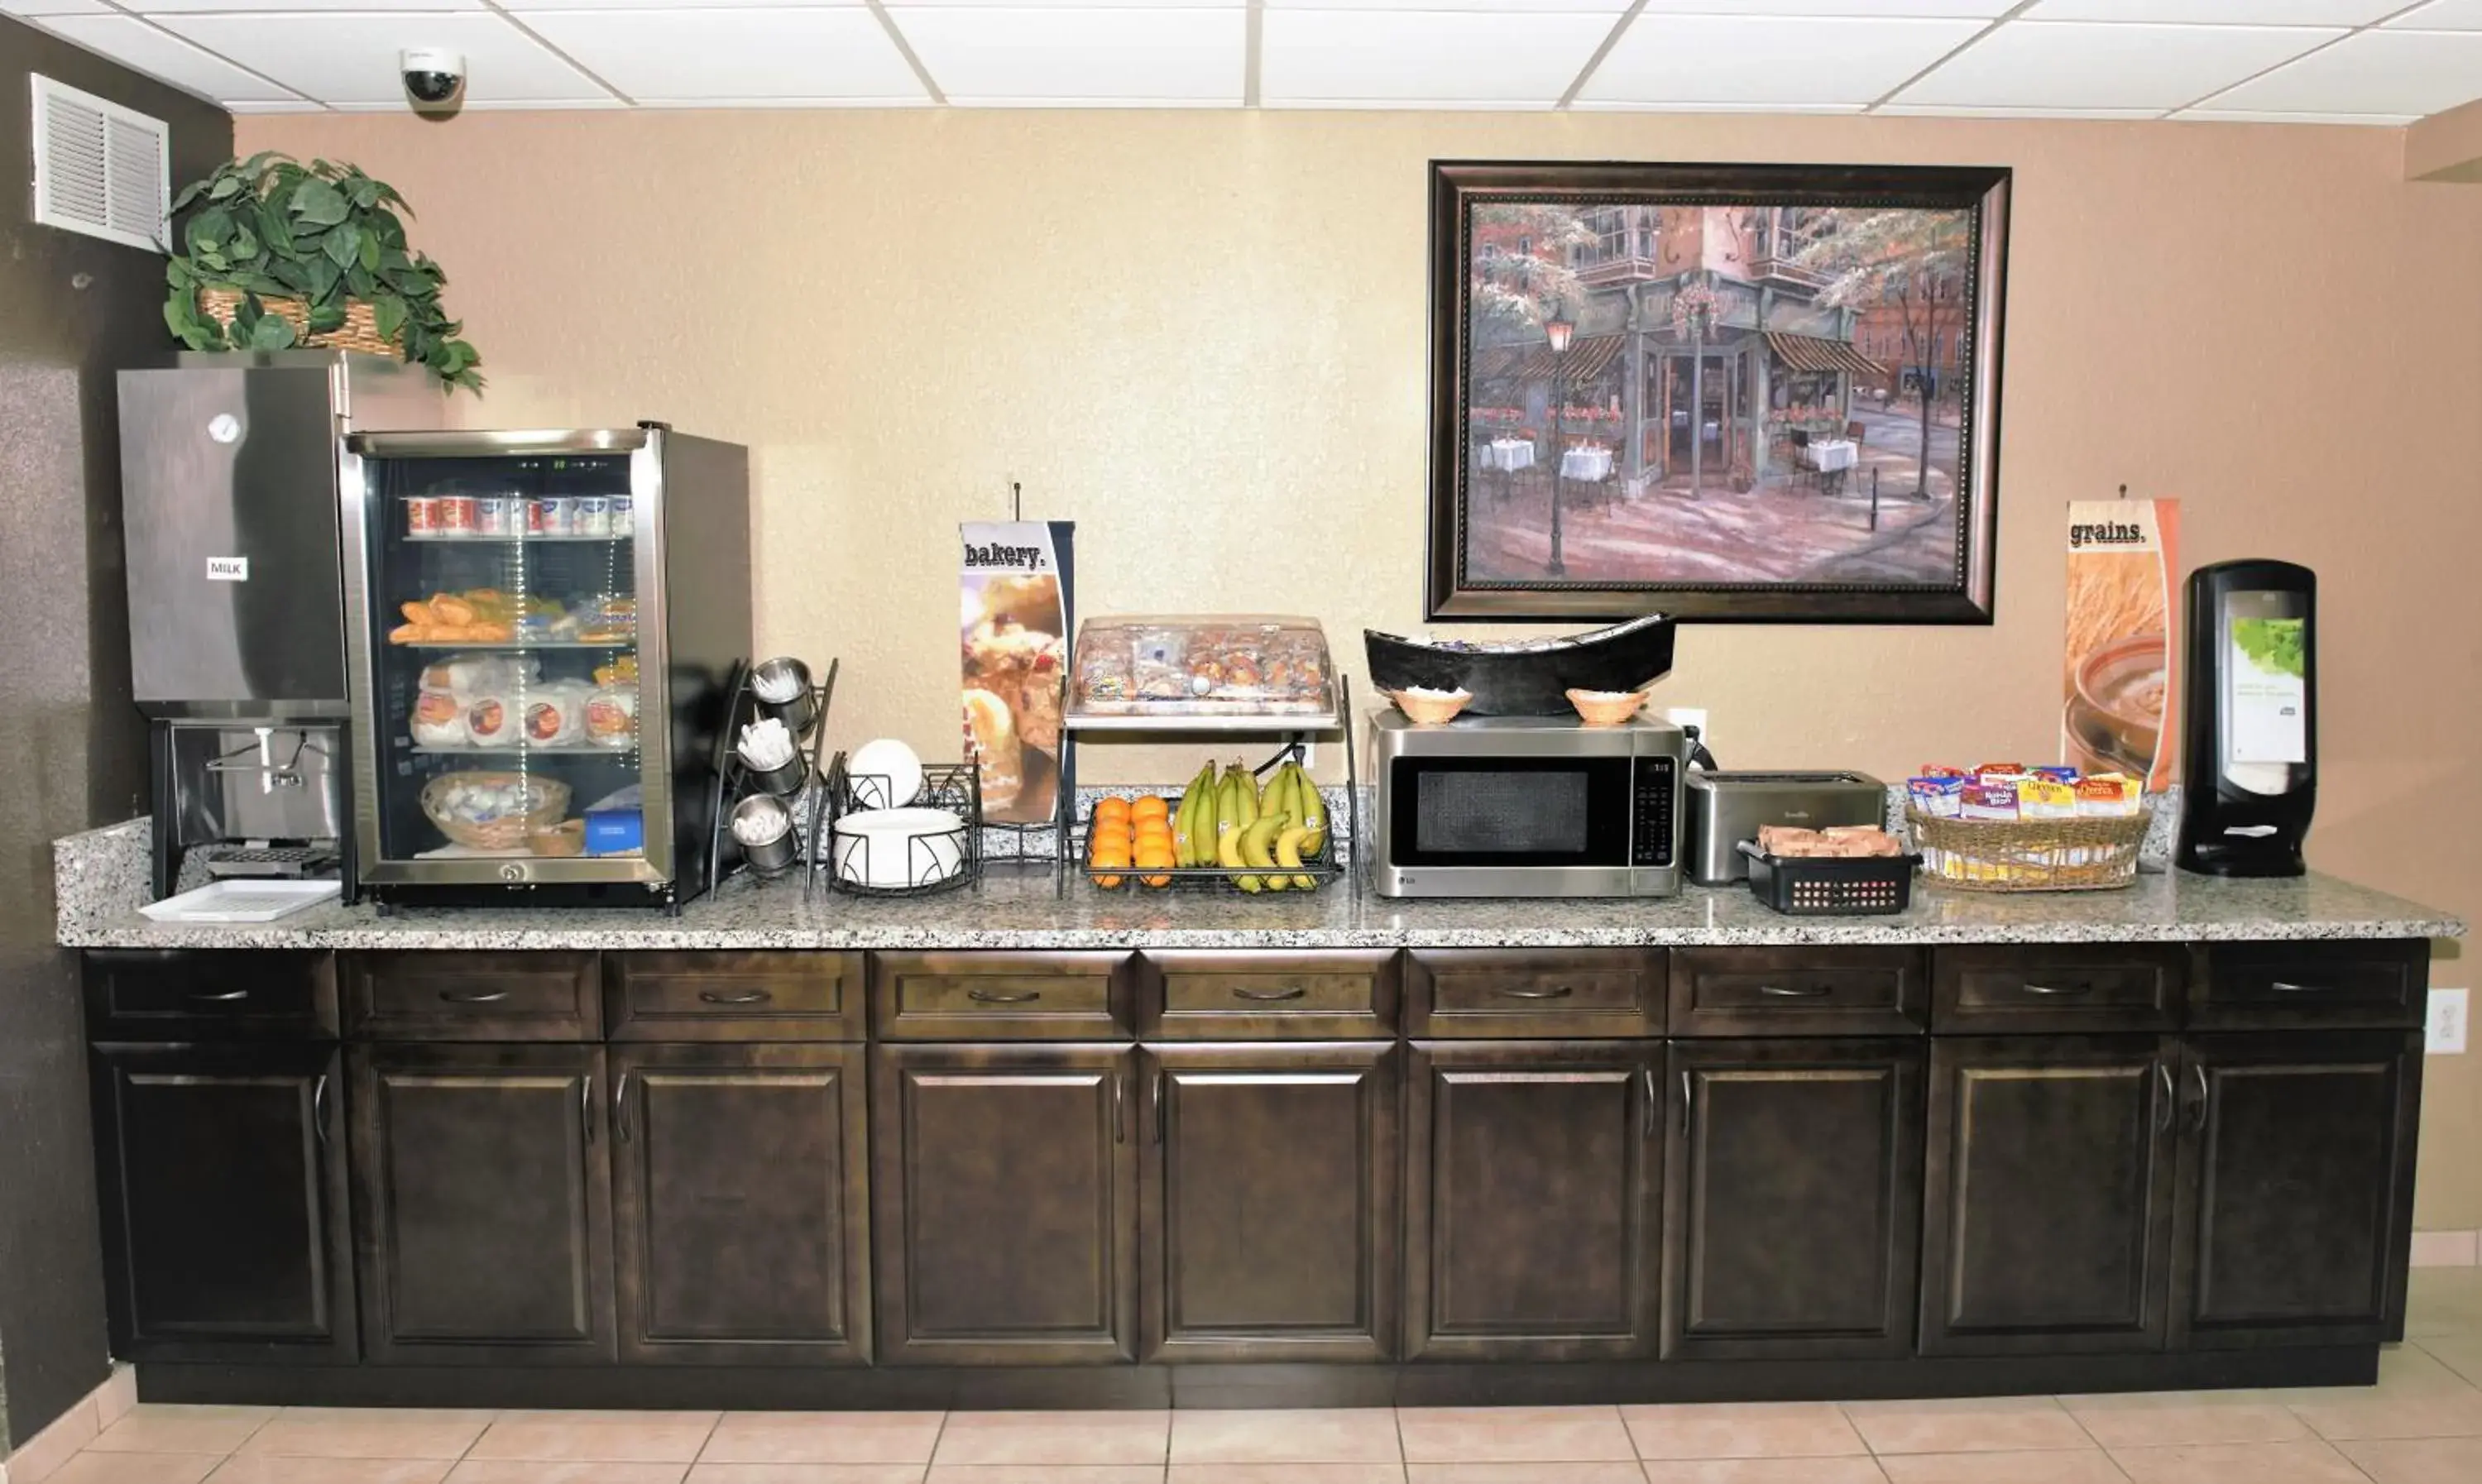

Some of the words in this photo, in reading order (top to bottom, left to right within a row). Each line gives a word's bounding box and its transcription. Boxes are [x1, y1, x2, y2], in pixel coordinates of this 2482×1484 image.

[2071, 520, 2146, 548] grains.
[211, 562, 242, 574] MILK
[965, 542, 1046, 571] bakery.
